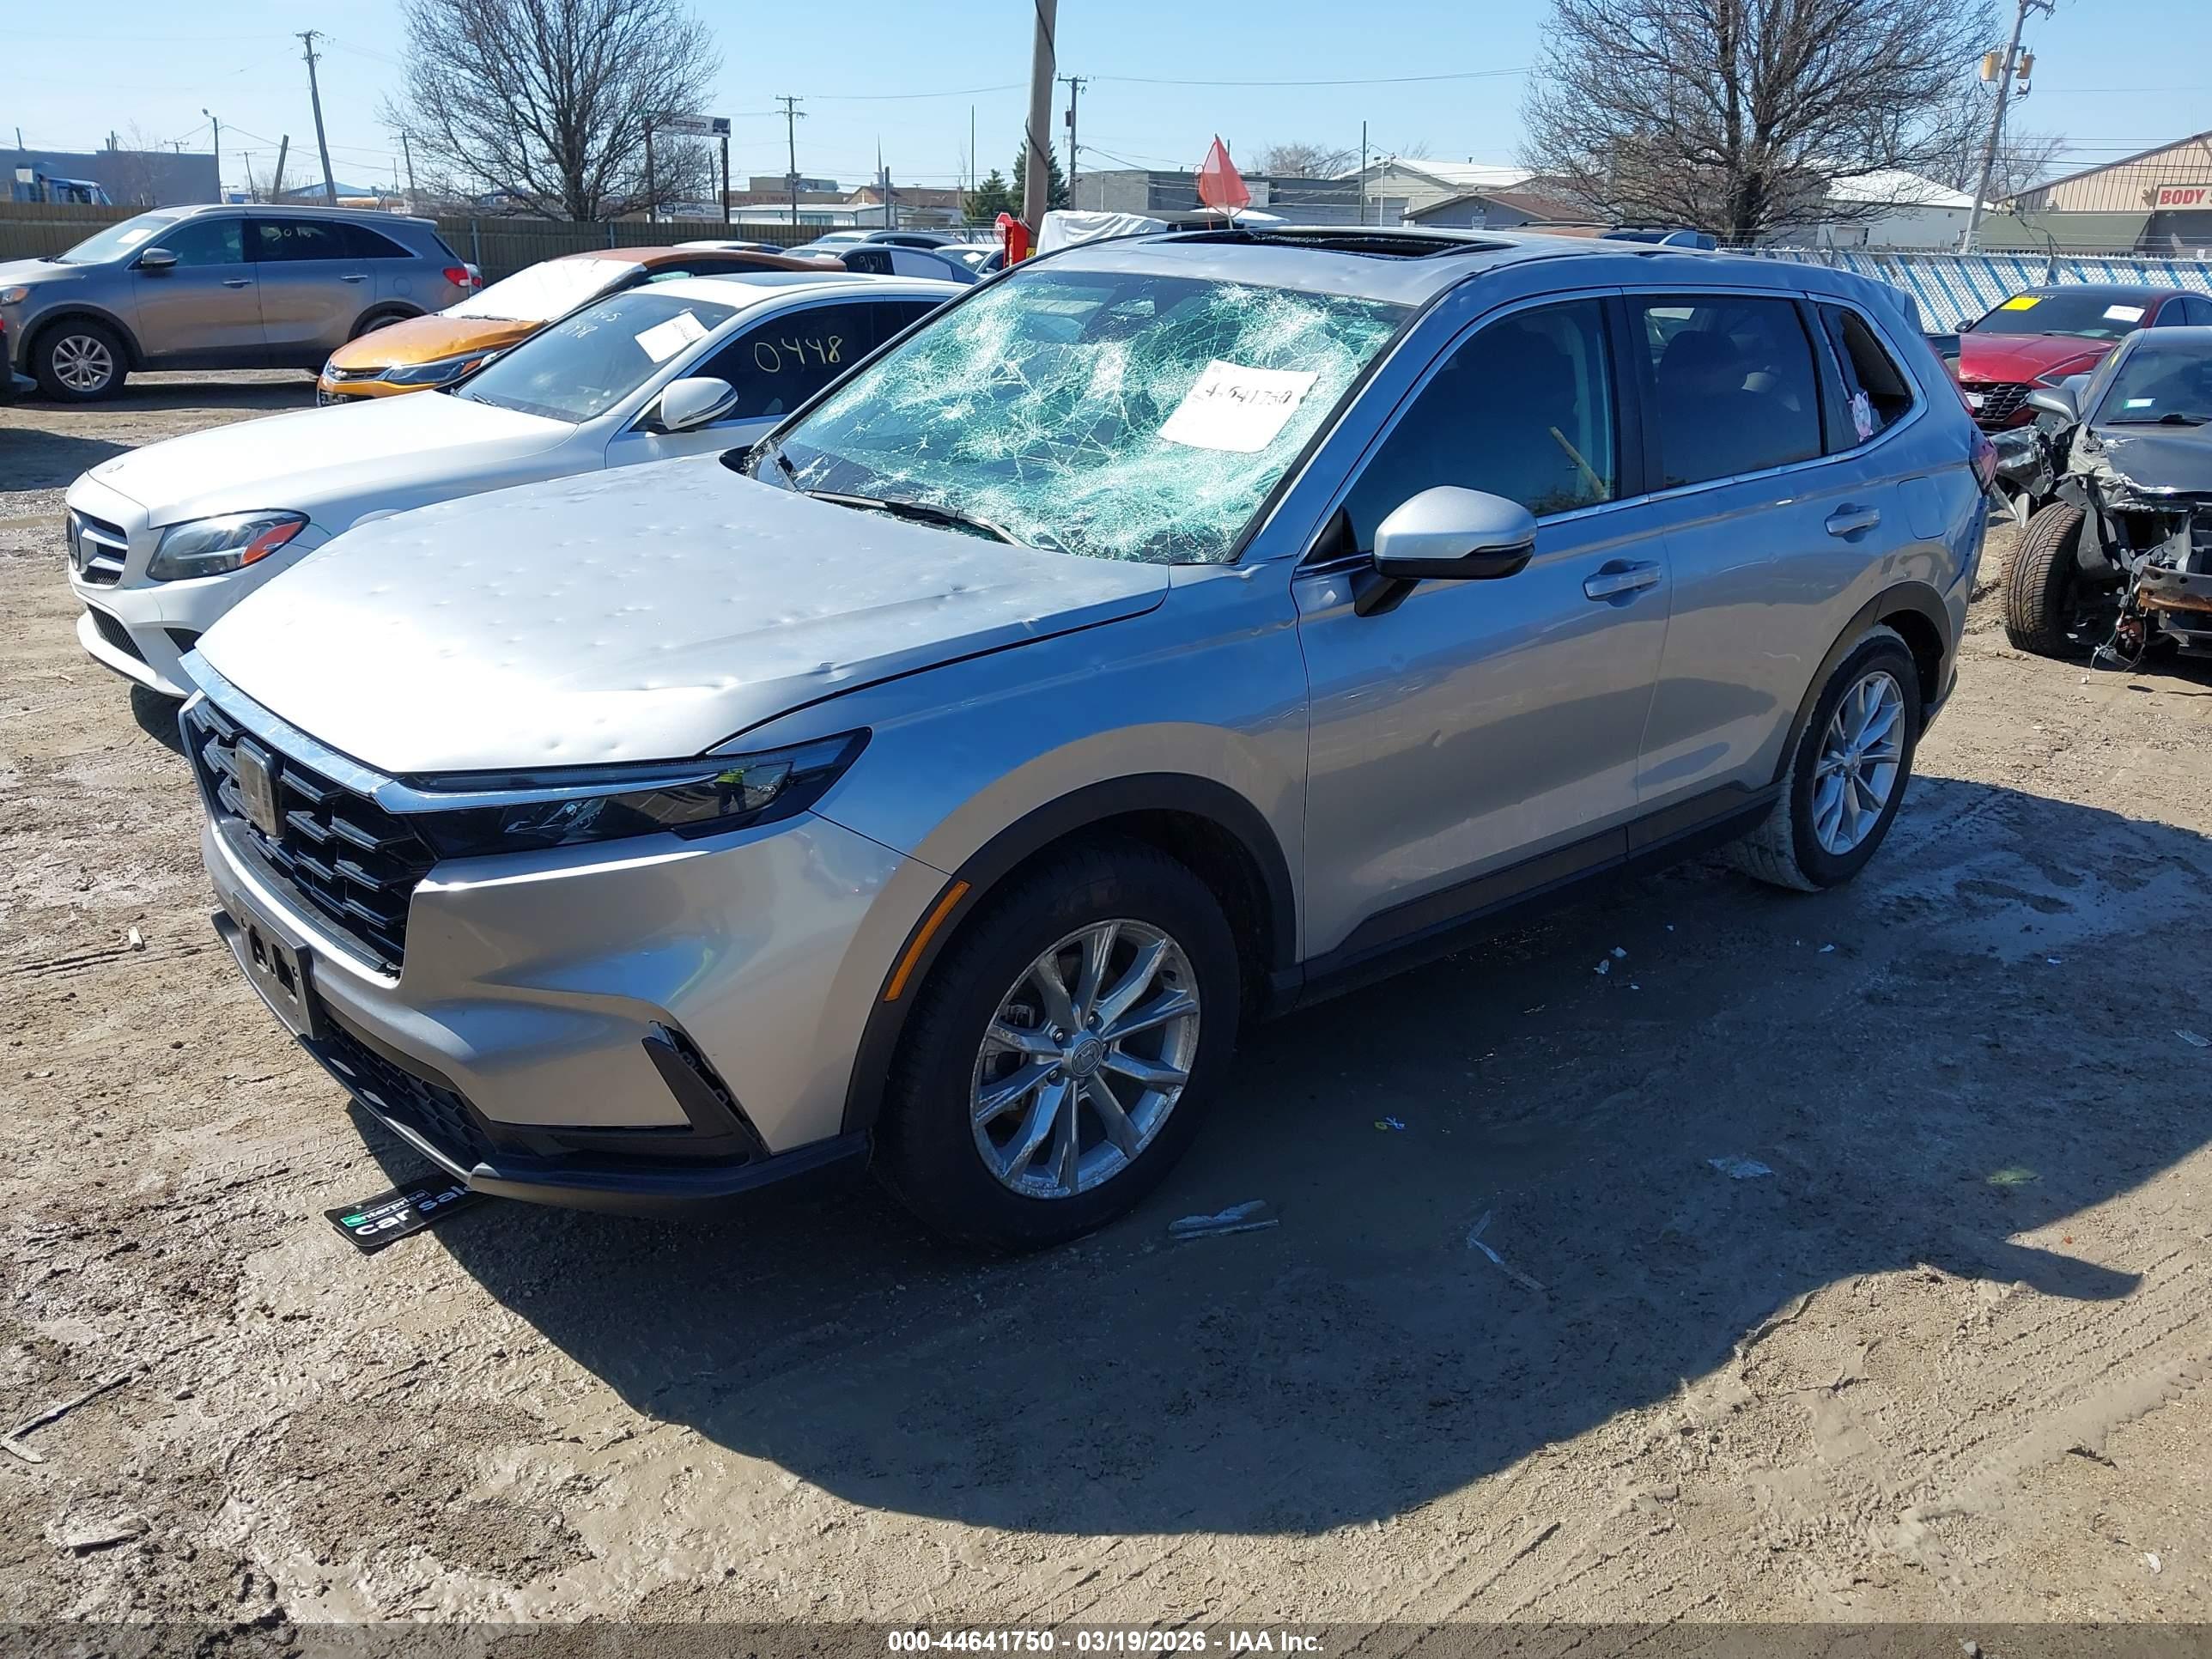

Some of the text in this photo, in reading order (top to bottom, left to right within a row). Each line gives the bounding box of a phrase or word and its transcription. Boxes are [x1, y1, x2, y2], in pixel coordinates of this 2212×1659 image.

[2160, 190, 2206, 204] BODY
[755, 335, 842, 373] 0448
[348, 1192, 426, 1224] enterprise
[355, 1208, 410, 1236] car
